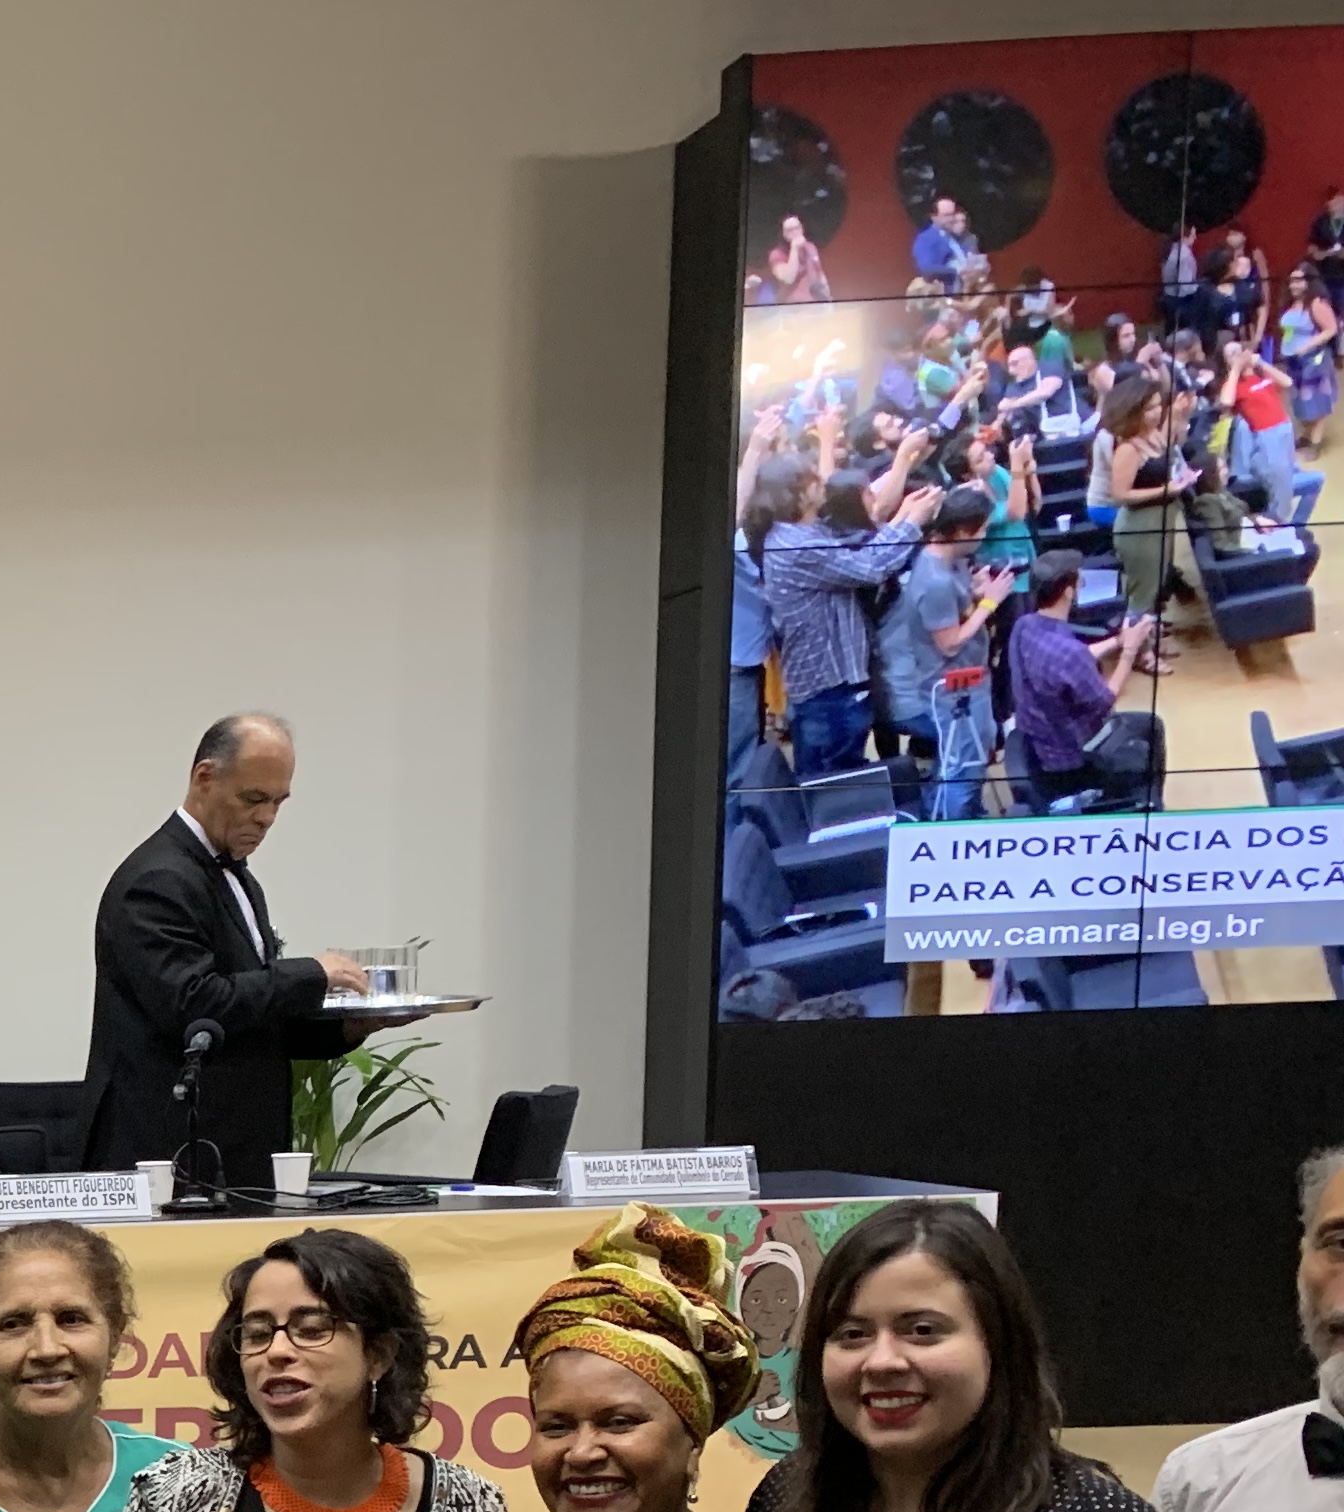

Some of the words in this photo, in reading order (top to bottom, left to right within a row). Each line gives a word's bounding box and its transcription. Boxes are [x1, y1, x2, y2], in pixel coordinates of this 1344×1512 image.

[910, 841, 937, 862] A
[952, 828, 1232, 860] IMPORTÂNCIA
[1247, 825, 1329, 849] DOS
[910, 879, 1014, 904] PARA
[1029, 878, 1056, 899] A
[903, 913, 1265, 950] www.camara.leg.br
[584, 1159, 614, 1173] MARIA
[617, 1159, 627, 1172] DE
[631, 1156, 662, 1171] FÁTIMA
[667, 1157, 704, 1170] BATISTA
[707, 1156, 742, 1168] BARROS
[16, 1179, 70, 1195] BENEDETTI
[73, 1177, 134, 1193] FIGUEIREDO
[82, 1194, 97, 1207] do
[103, 1193, 136, 1206] ISPN
